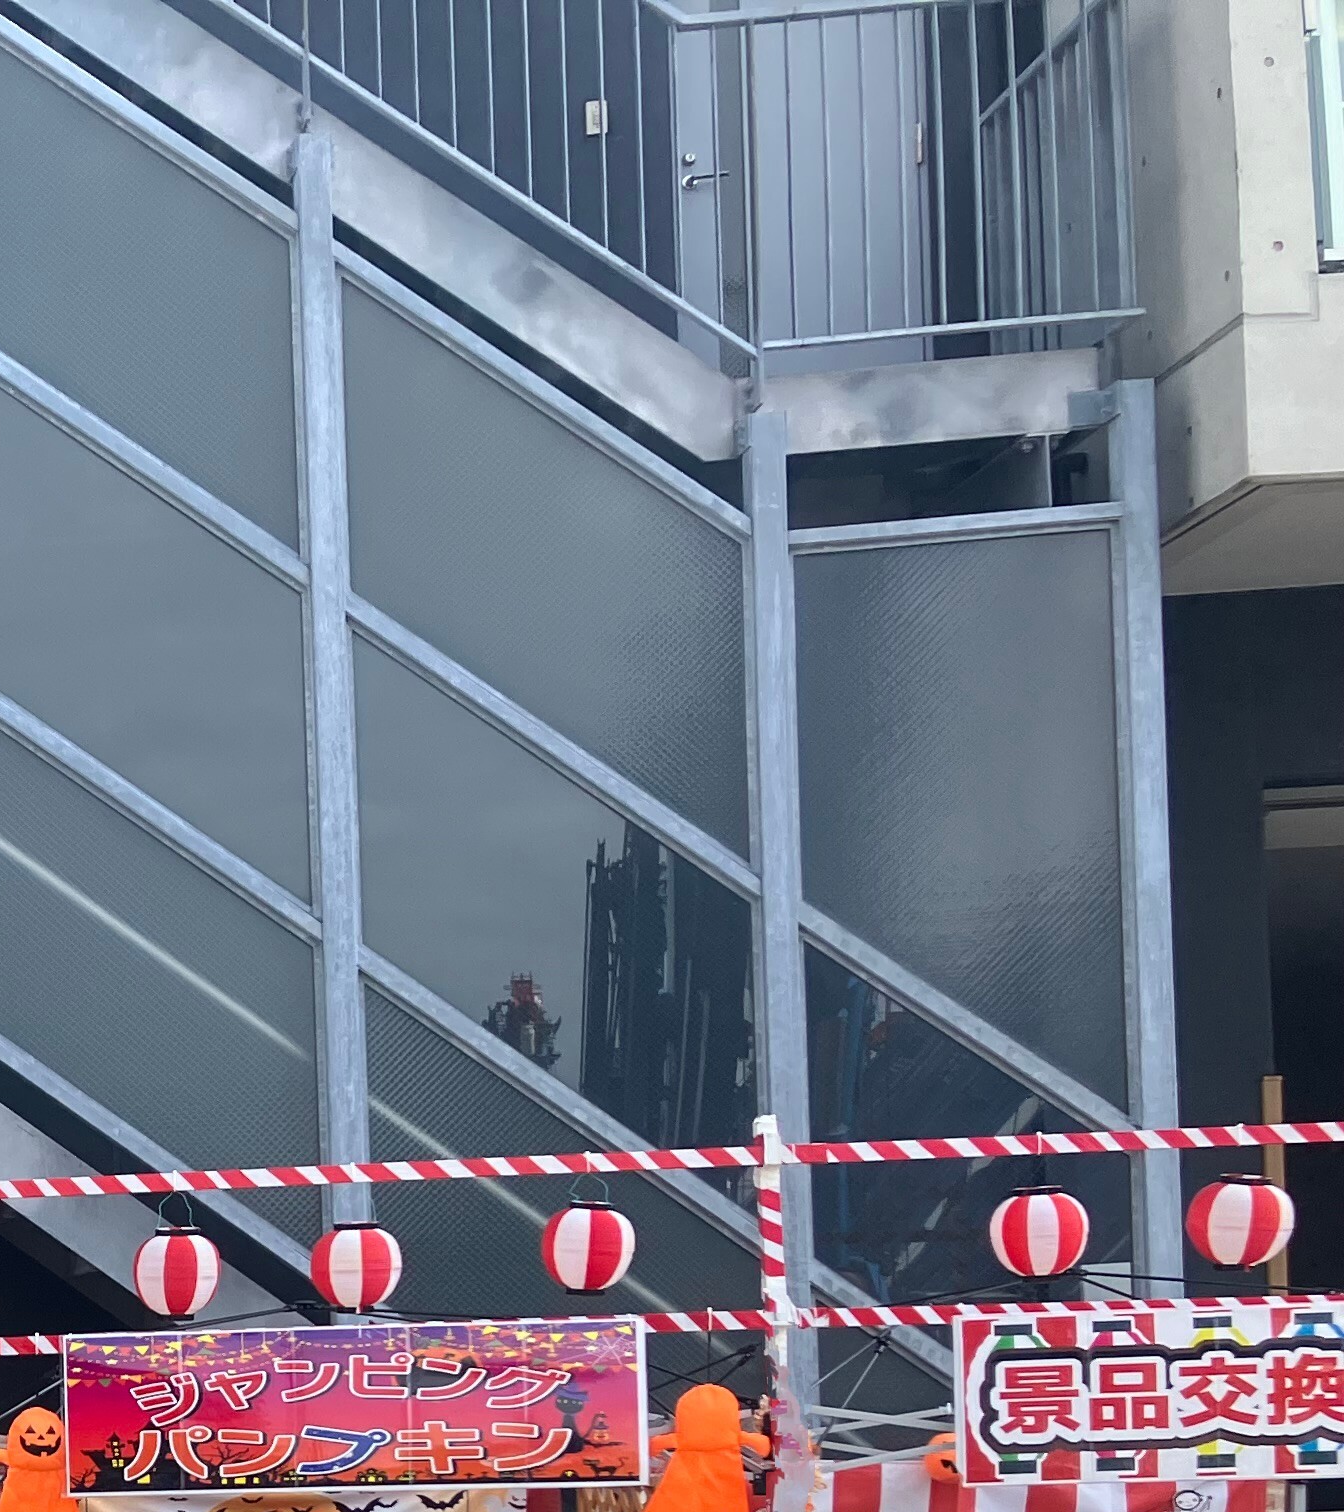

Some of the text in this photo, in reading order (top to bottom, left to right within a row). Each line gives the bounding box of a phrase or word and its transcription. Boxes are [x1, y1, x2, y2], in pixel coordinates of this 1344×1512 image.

[129, 1354, 572, 1427] ジャンピング
[997, 1350, 1344, 1437] 景品交換
[123, 1421, 574, 1481] パンプキン
